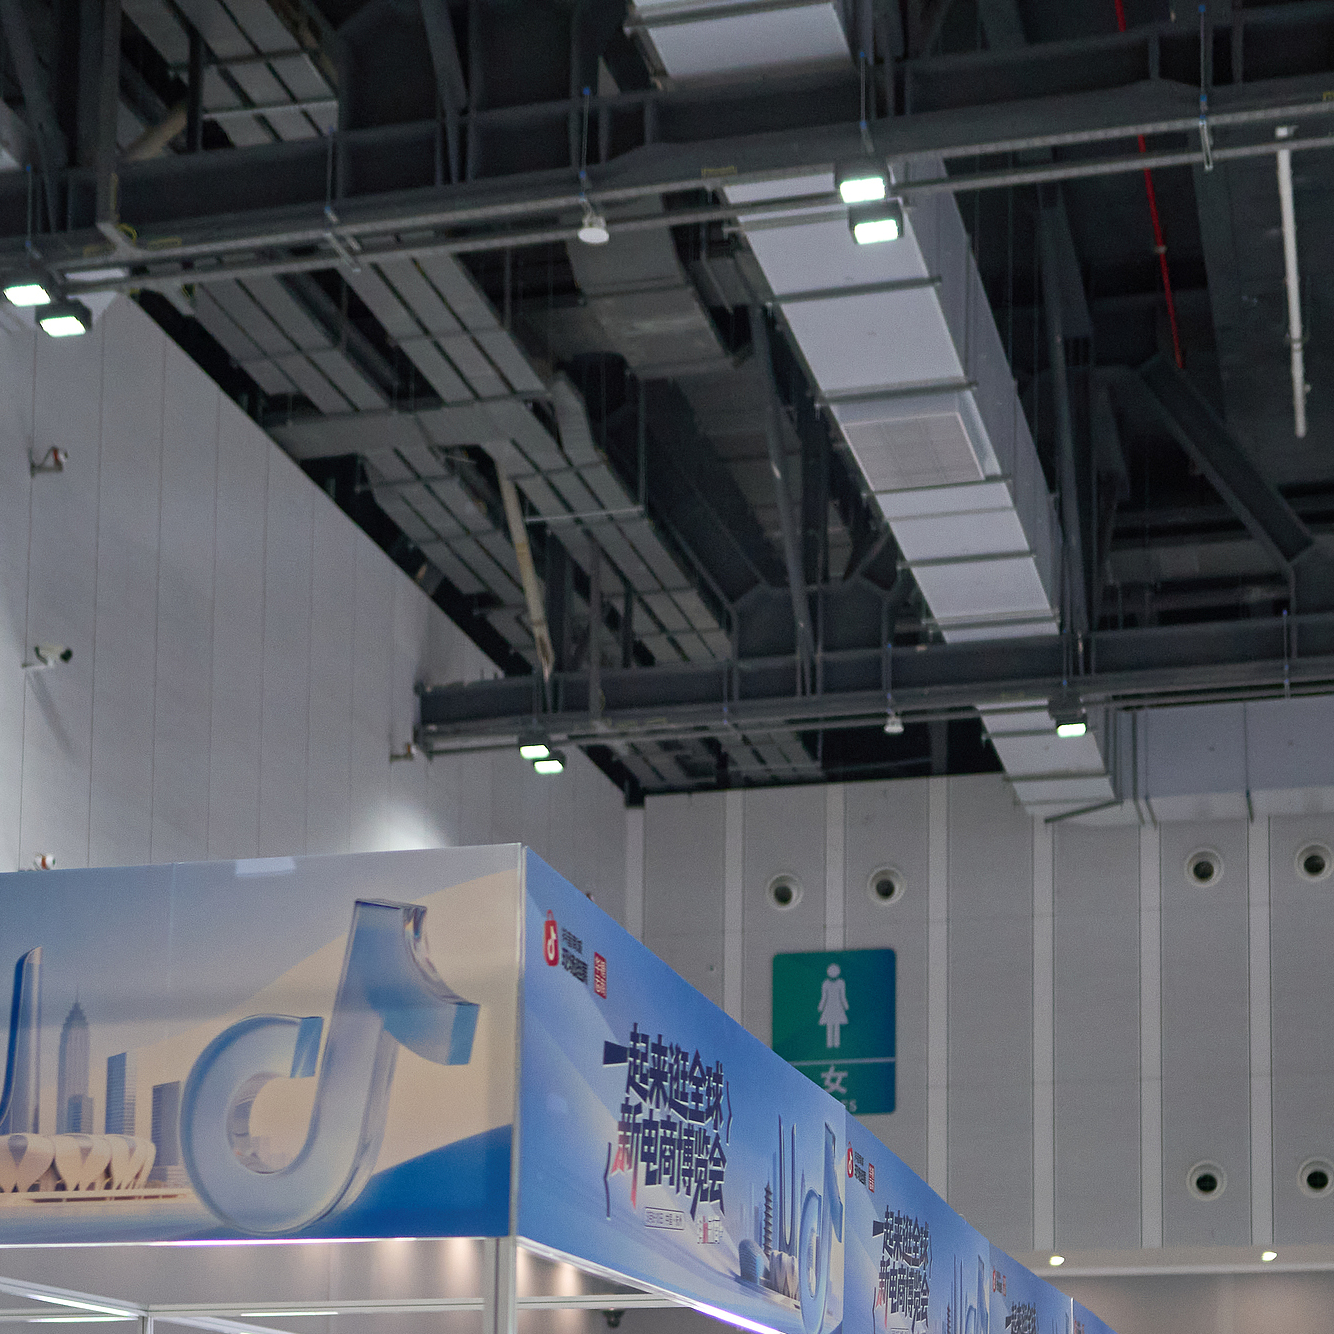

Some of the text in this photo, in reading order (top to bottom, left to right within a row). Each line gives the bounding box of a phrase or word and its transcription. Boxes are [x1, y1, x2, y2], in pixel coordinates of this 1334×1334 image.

[602, 1022, 725, 1133] 一起来逛全球
[820, 1066, 849, 1094] 女
[610, 1097, 727, 1222] 新电商博览会
